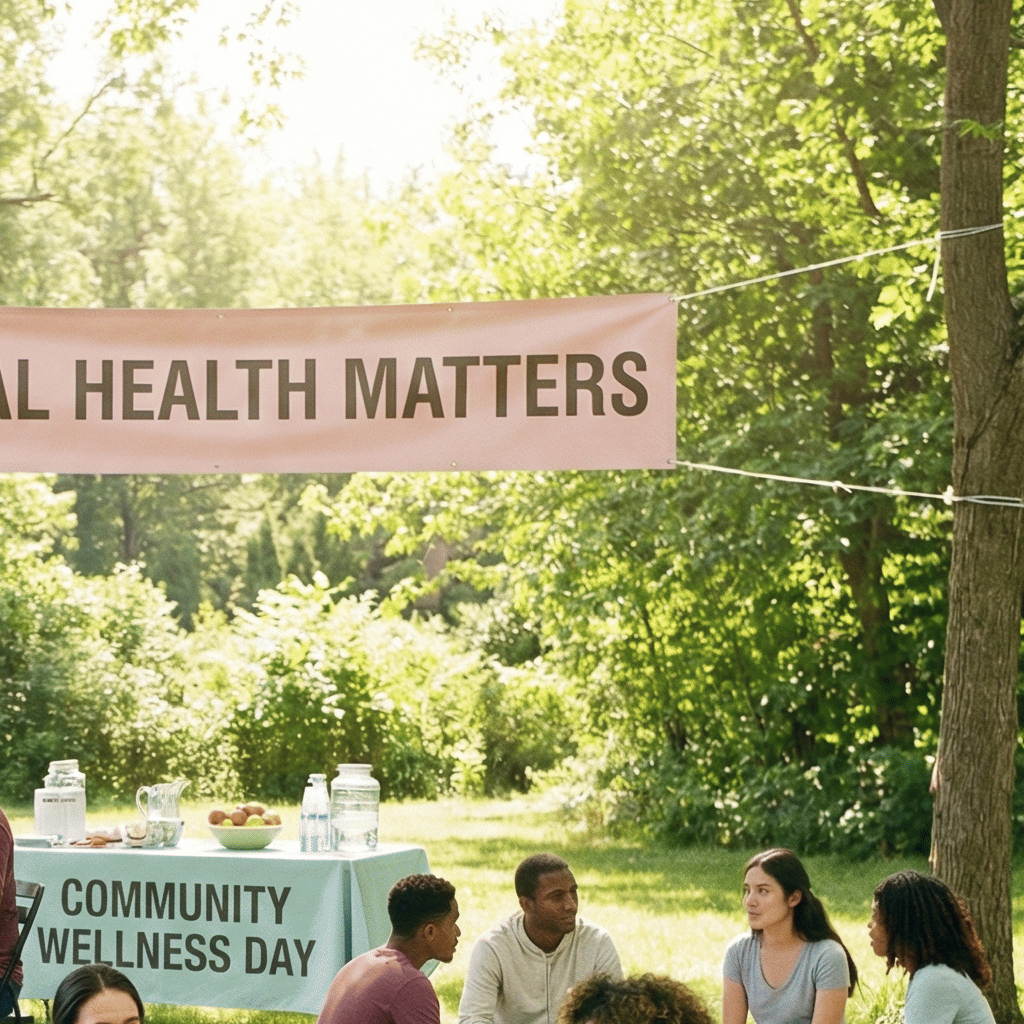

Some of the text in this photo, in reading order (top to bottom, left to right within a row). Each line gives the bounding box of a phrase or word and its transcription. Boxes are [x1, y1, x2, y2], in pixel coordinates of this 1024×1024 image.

[75, 358, 316, 420] HEALTH
[345, 351, 649, 420] MATTERS
[61, 878, 292, 925] COMMUNITY
[37, 926, 317, 978] WELLNESS DAY
